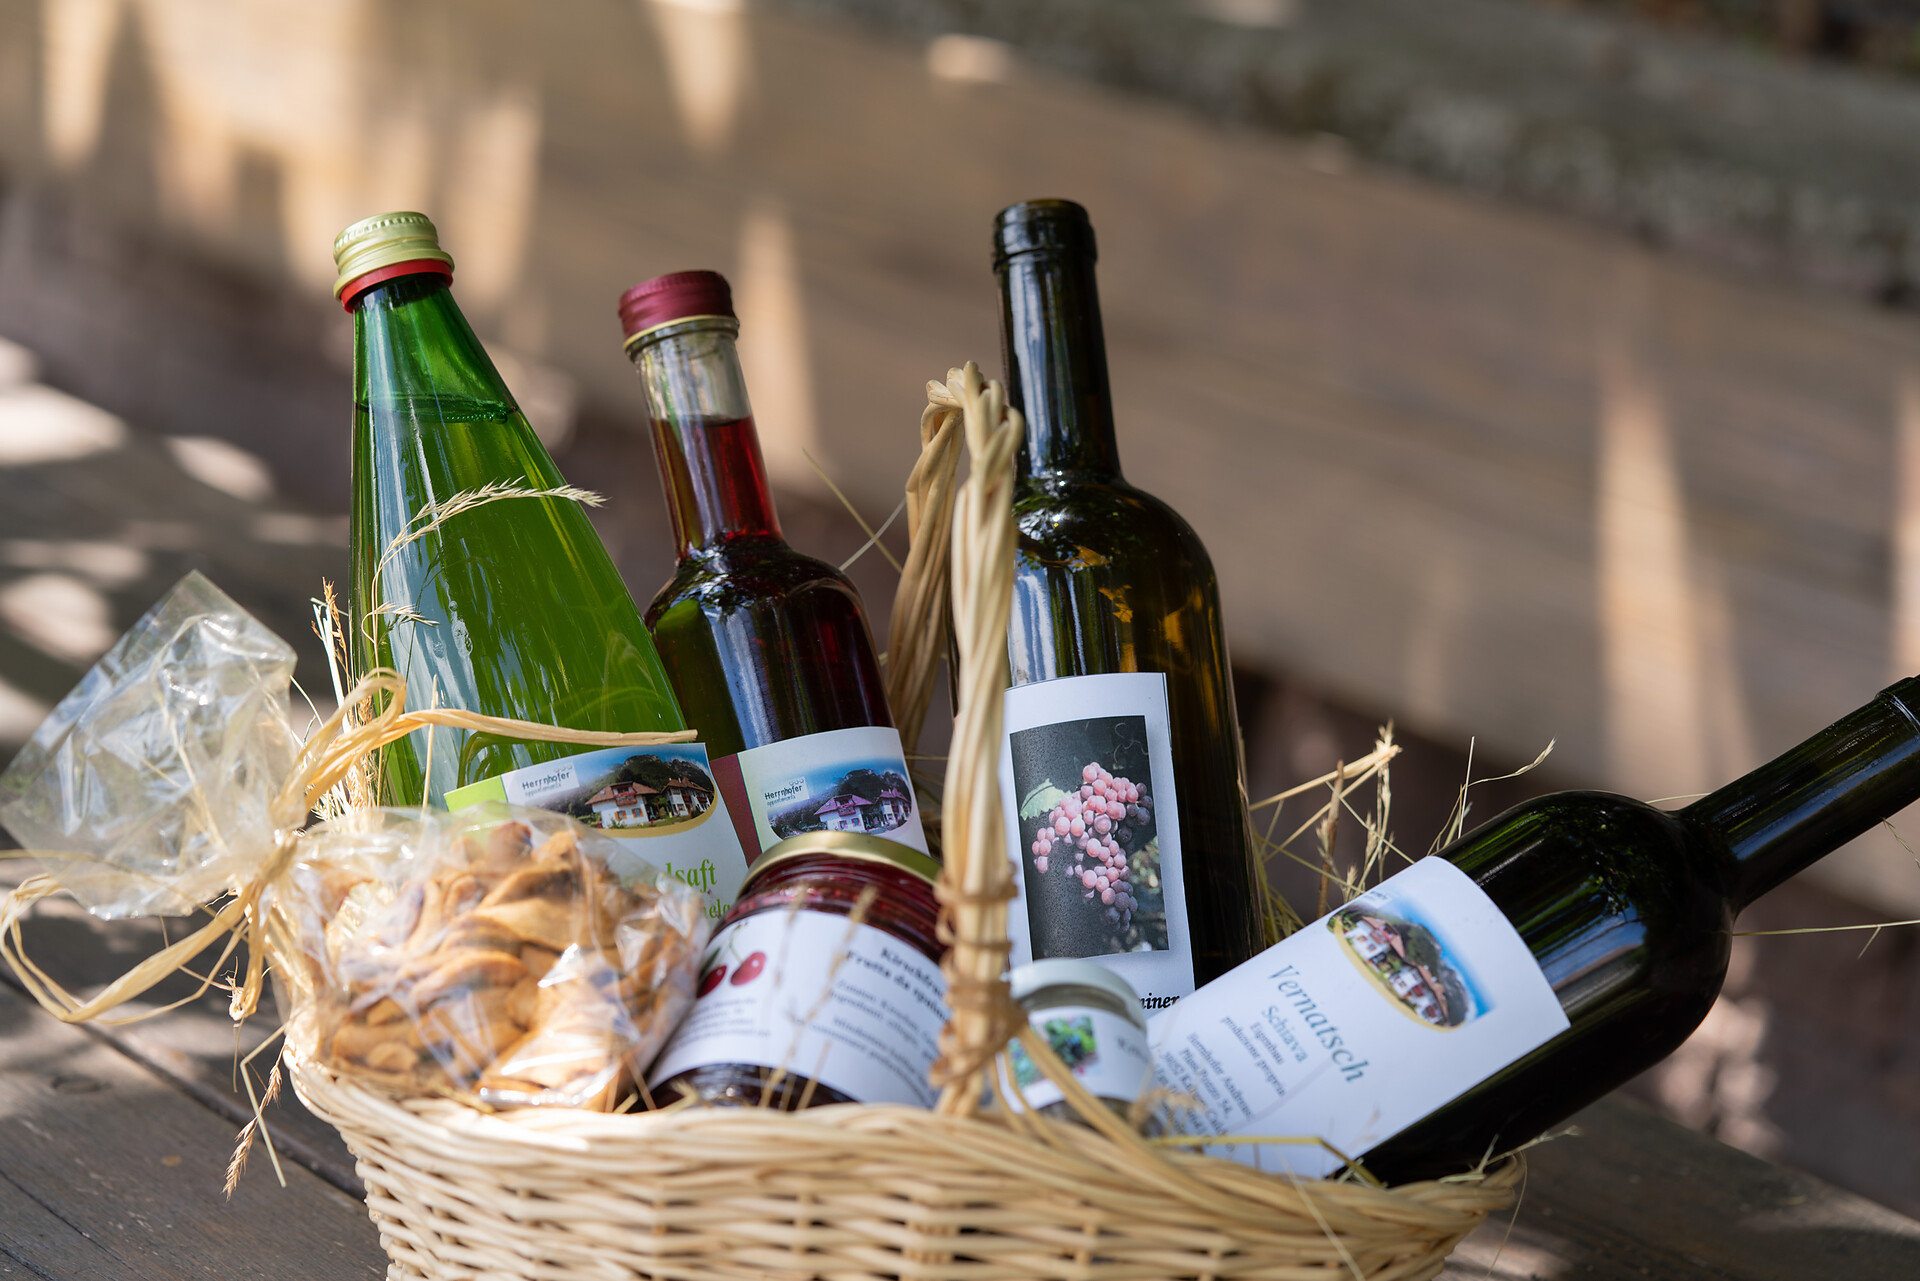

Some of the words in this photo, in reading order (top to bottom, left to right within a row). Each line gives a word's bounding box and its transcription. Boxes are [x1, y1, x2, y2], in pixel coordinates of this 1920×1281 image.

[522, 770, 571, 791] Herrnhofer
[764, 783, 803, 802] Herrnhofer
[664, 858, 718, 893] lsaft
[1262, 1004, 1308, 1064] Schiava
[1268, 964, 1370, 1083] Vernatsch
